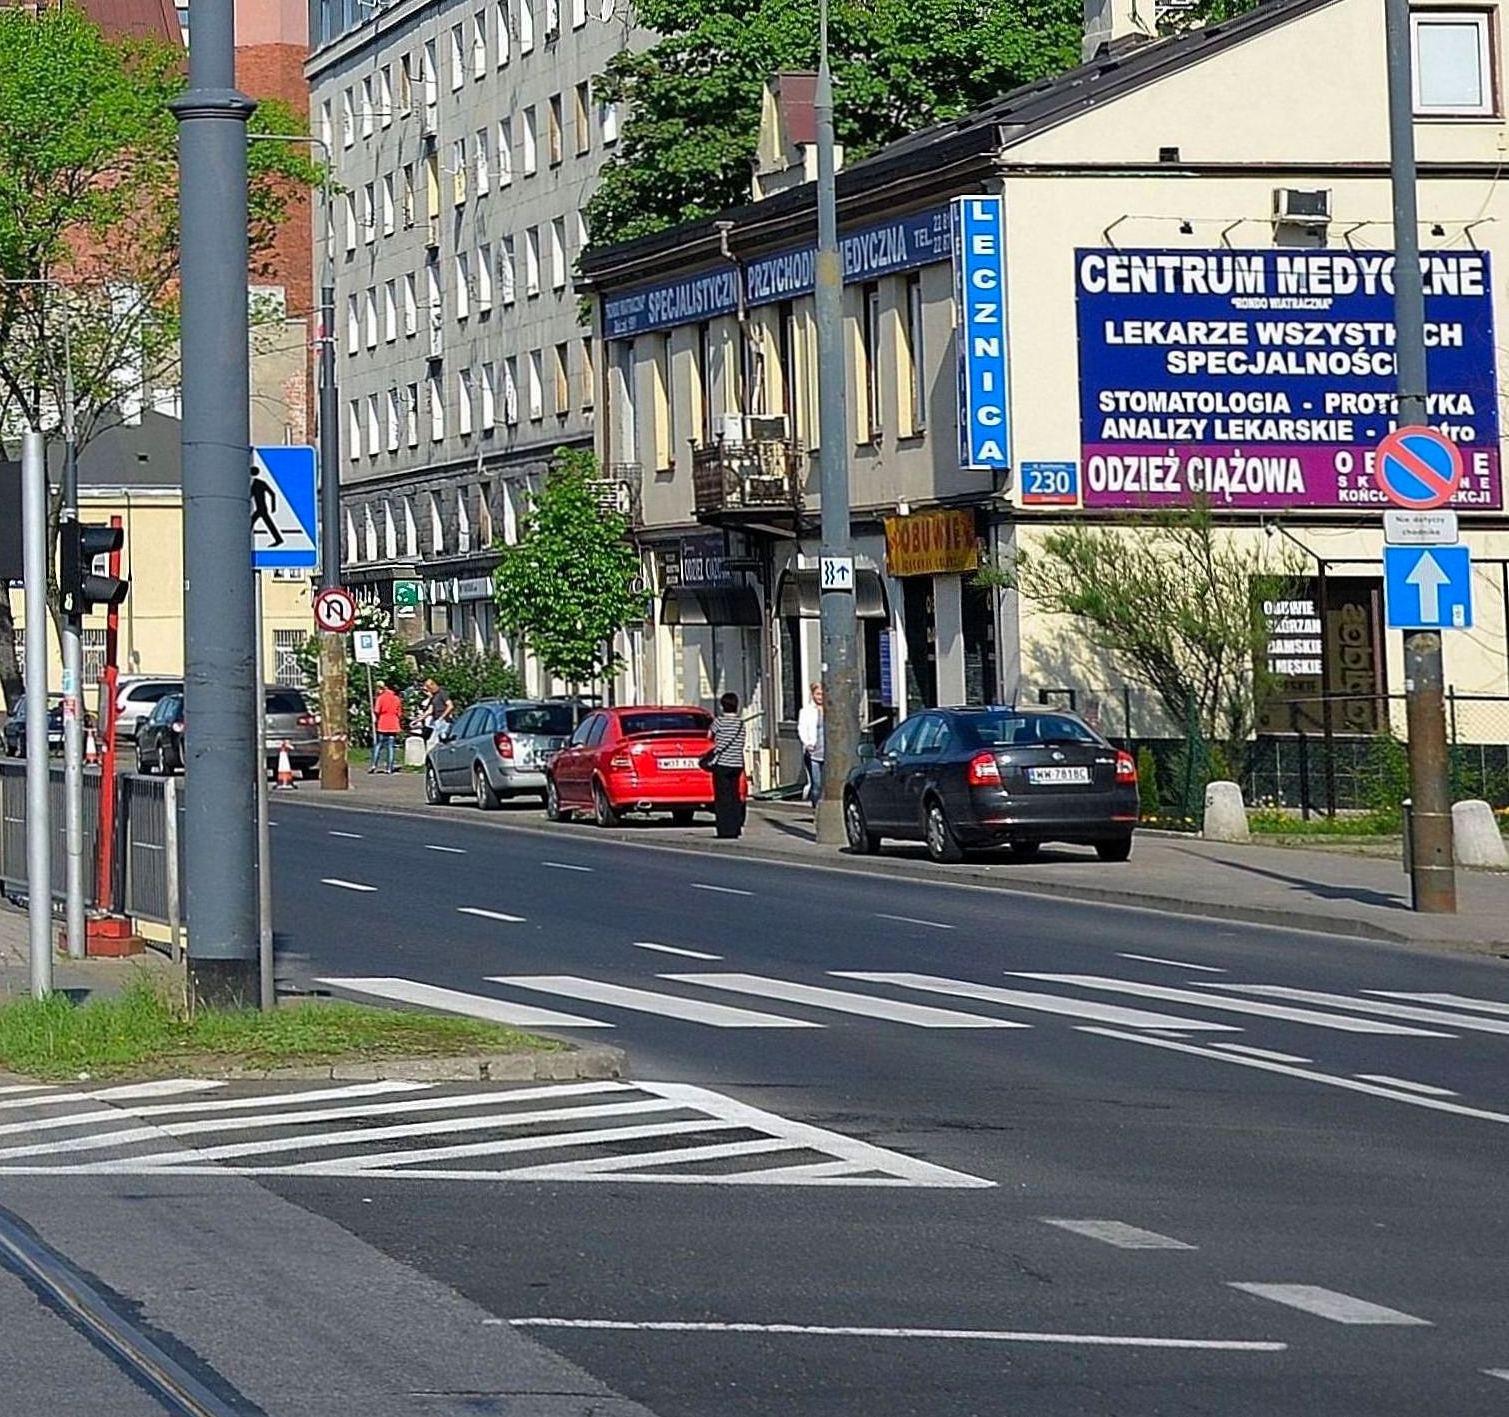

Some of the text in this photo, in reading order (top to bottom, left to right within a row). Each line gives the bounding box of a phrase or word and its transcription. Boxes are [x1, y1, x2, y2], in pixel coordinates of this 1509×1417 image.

[1079, 255, 1266, 295] CENTRUM
[647, 270, 740, 324] SPECJALISTYCZN
[972, 200, 1005, 462] LECZNICA
[1105, 321, 1248, 345] LEKARZE
[1099, 391, 1291, 415] STOMATOLOGIA
[1101, 418, 1208, 442] ANALIZY
[1214, 419, 1354, 442] LEKARSKIE
[1029, 471, 1070, 493] 230
[1088, 448, 1305, 502] ODZIEŻ CIĄŻOWA
